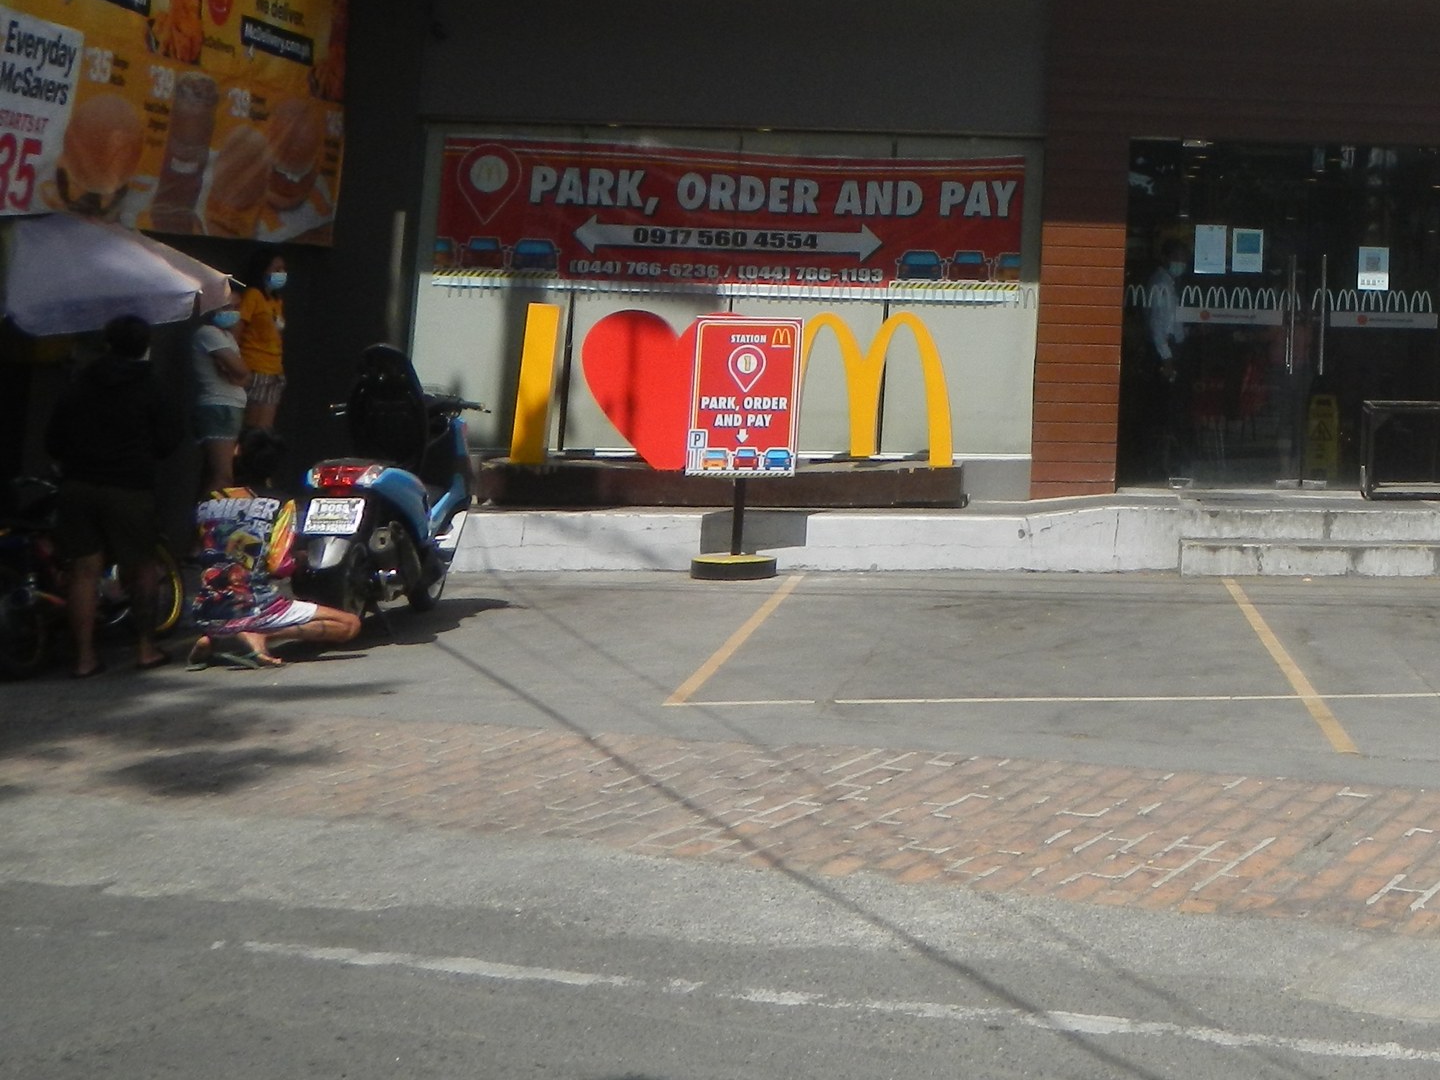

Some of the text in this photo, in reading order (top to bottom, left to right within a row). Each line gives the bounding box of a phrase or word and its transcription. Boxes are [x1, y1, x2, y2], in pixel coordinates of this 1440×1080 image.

[4, 20, 78, 78] Everyday
[0, 61, 70, 106] McSavers
[529, 165, 1018, 217] PARK, ORDER AND PAY
[634, 227, 818, 250] 0917 560 4554
[569, 259, 622, 276] (044)
[626, 261, 720, 279] 766-6236
[737, 265, 791, 282] (044)
[731, 334, 767, 344] STATION
[701, 396, 788, 411] PARK, ORDER
[714, 414, 772, 427] AND PAY
